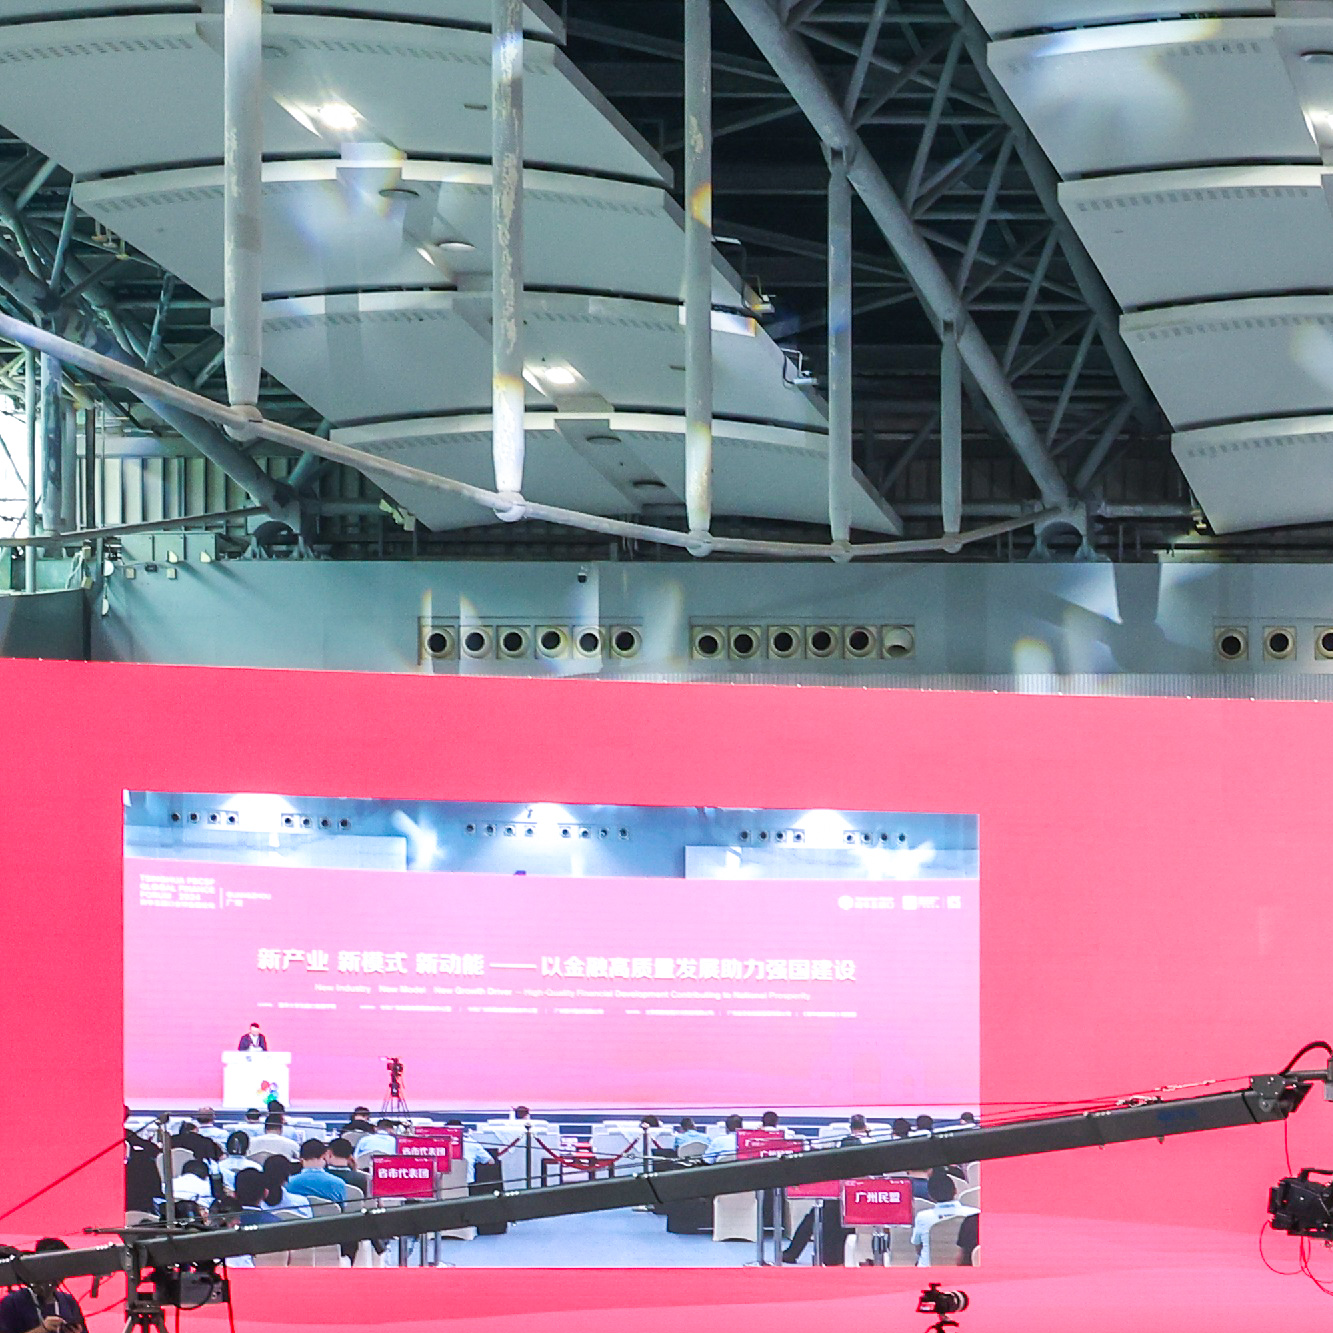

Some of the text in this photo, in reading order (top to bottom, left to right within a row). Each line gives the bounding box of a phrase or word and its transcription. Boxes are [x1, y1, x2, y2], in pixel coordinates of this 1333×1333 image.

[257, 948, 330, 971] 新产业
[337, 951, 408, 974] 新模式
